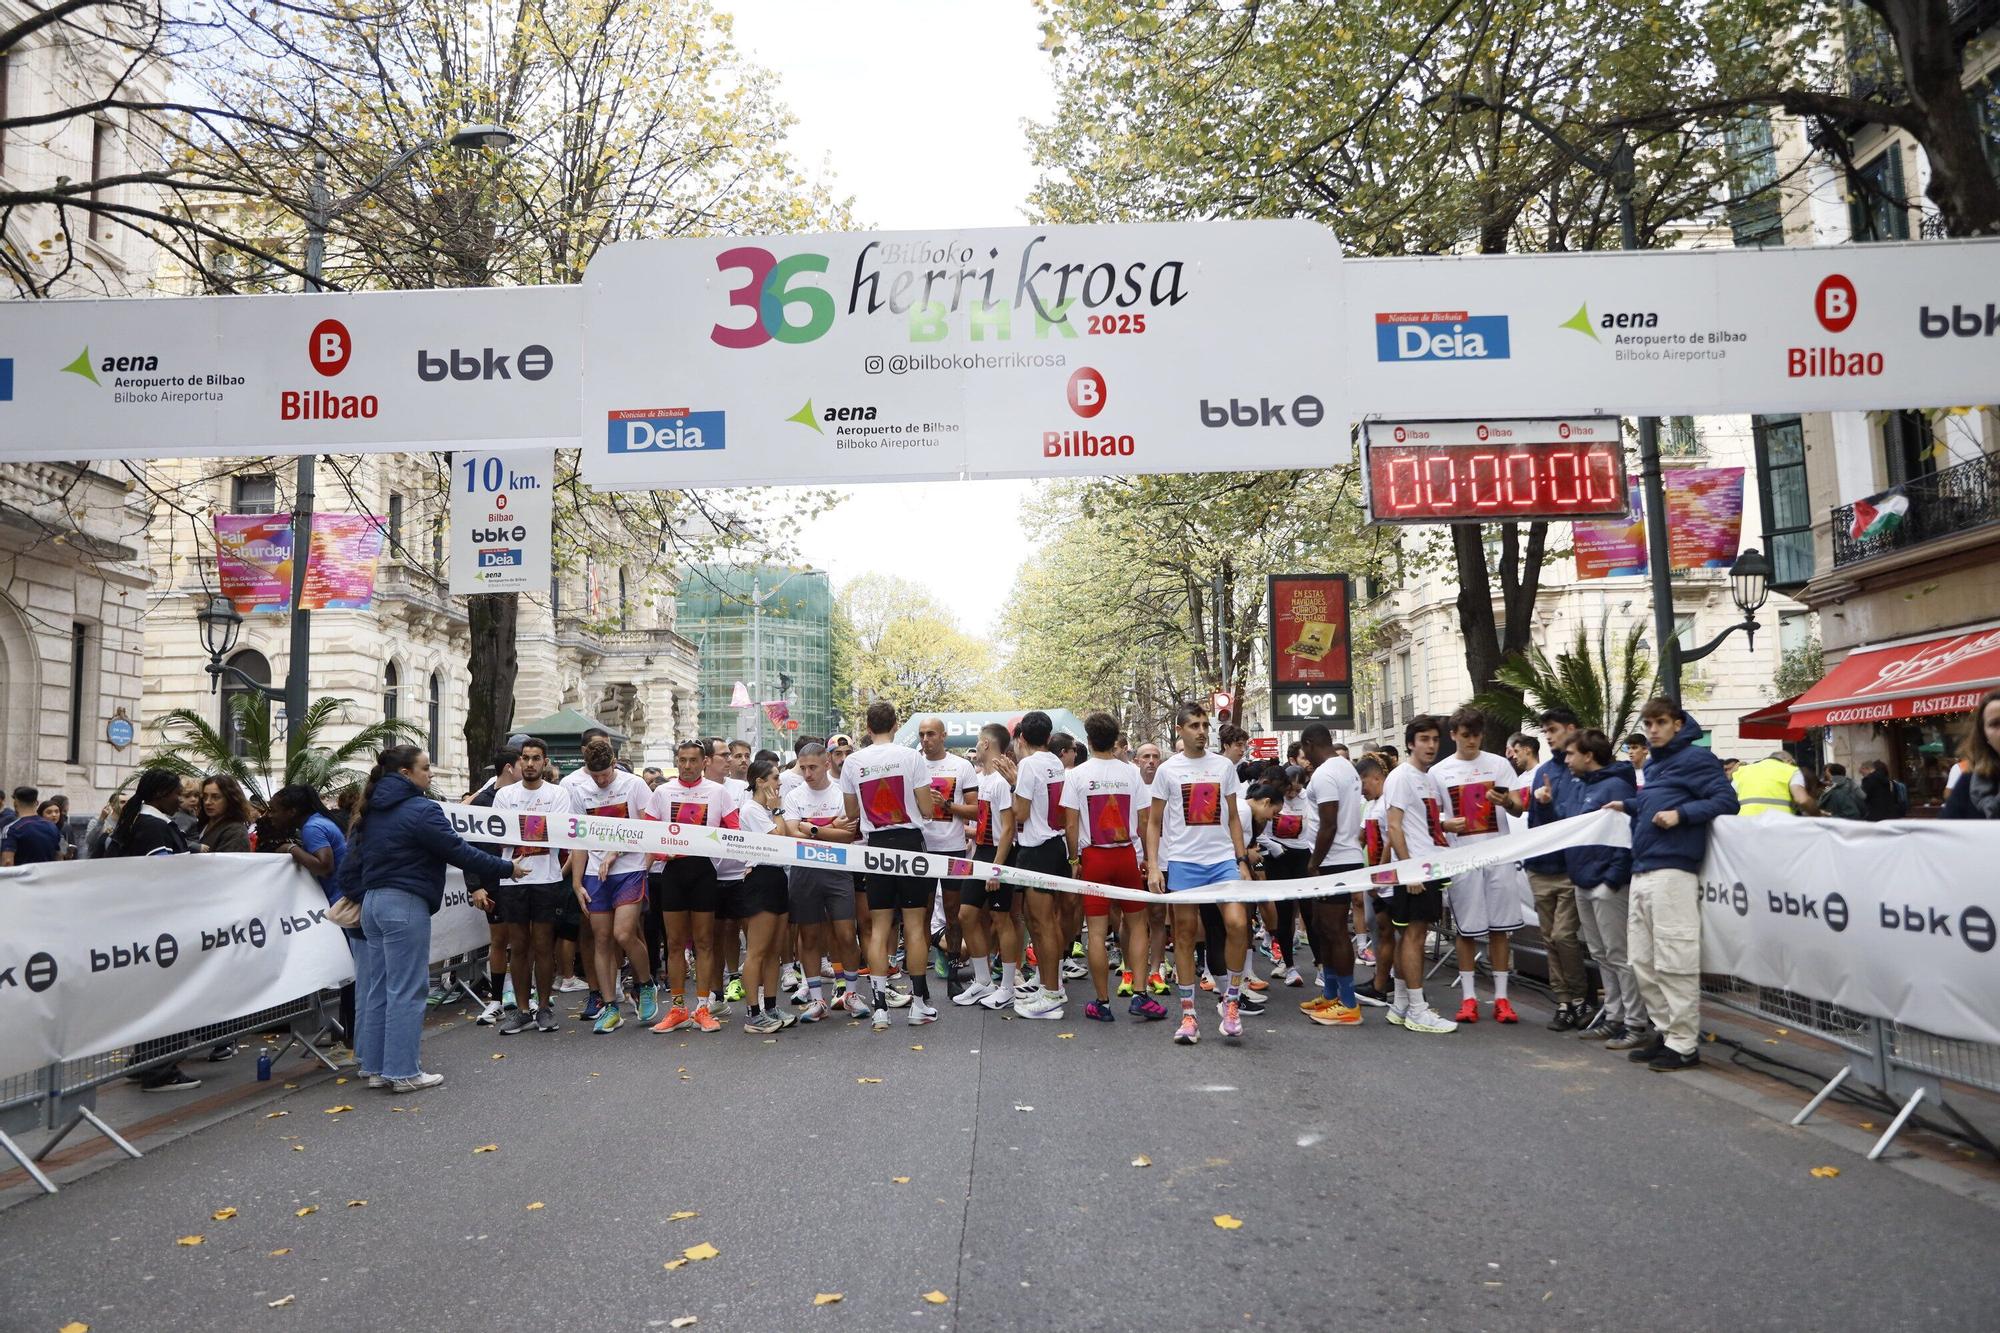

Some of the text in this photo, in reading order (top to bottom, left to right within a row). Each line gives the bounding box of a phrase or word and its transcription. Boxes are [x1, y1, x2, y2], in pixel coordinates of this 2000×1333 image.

[881, 239, 974, 266] Bilboko
[710, 236, 1189, 349] 36 herri krosa
[1088, 314, 1146, 335] 2025
[1421, 313, 1430, 321] de
[1432, 312, 1462, 321] Bizkaia
[1601, 313, 1658, 328] aena
[1398, 324, 1488, 358] Deia
[1615, 331, 1747, 346] Aeropuerto de Bilbao
[101, 355, 158, 372] aena
[417, 348, 511, 382] bbk
[888, 354, 1067, 376] @bilbokoherrikrosa
[1615, 349, 1726, 361] Bilboko Aireportua
[1787, 348, 1884, 378] Bilbao
[115, 374, 245, 389] Aeropuerto de Bilbao
[114, 391, 224, 404] Bilboko Aireportua
[281, 391, 378, 421] Bilbao
[657, 409, 684, 418] Bizkaia
[824, 406, 877, 421] aena
[1200, 398, 1286, 428] bbk
[626, 420, 705, 450] Deia
[837, 422, 960, 436] Aeropuerto de Bilbao
[837, 438, 939, 449] Bilboko Aireportua
[1043, 431, 1135, 457] Bilbao
[463, 457, 541, 492] 10 km.
[1389, 453, 1616, 509] 00:00:00
[488, 513, 514, 522] Bilbao
[219, 530, 247, 544] Fair
[472, 528, 509, 543] bbk
[221, 544, 290, 561] Saturday
[485, 553, 514, 566] Deia
[1293, 590, 1324, 598] EN ESTAS
[1319, 606, 1328, 614] DE
[1826, 692, 1982, 723] GOZOTEGIA PASTELERI
[449, 812, 485, 835] bk
[567, 818, 587, 838] 36
[616, 824, 644, 841] krosa
[660, 837, 689, 847] Bilbao
[721, 833, 745, 843] aena
[804, 846, 838, 863] Deia
[864, 851, 909, 875] bbk
[1768, 890, 1819, 919] bbk
[280, 908, 329, 936] bbk
[1880, 902, 1952, 937] bbk
[201, 924, 248, 951] bbk
[90, 942, 151, 973] bbk
